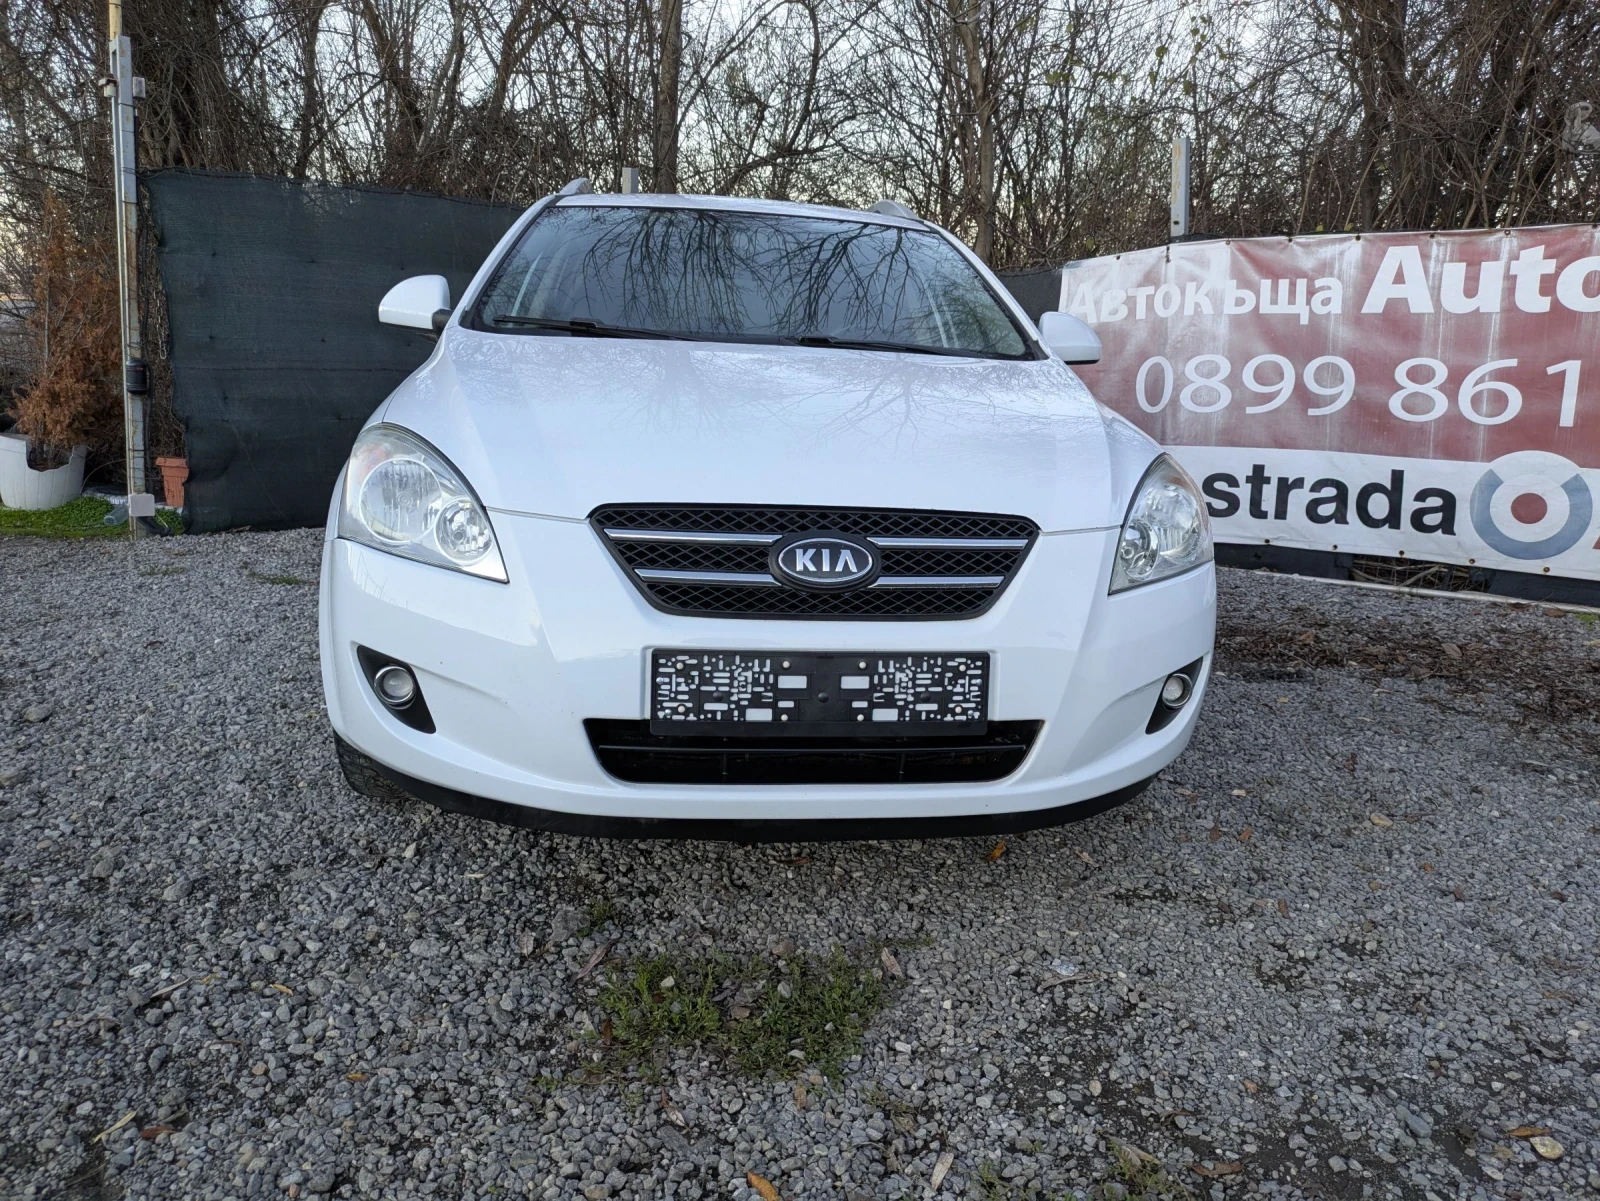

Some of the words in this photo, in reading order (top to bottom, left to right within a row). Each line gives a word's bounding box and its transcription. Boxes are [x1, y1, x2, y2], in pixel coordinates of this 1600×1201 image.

[1135, 353, 1356, 416] 0899
[1388, 357, 1582, 427] 861
[1201, 463, 1457, 536] strada
[794, 548, 858, 573] KIA
